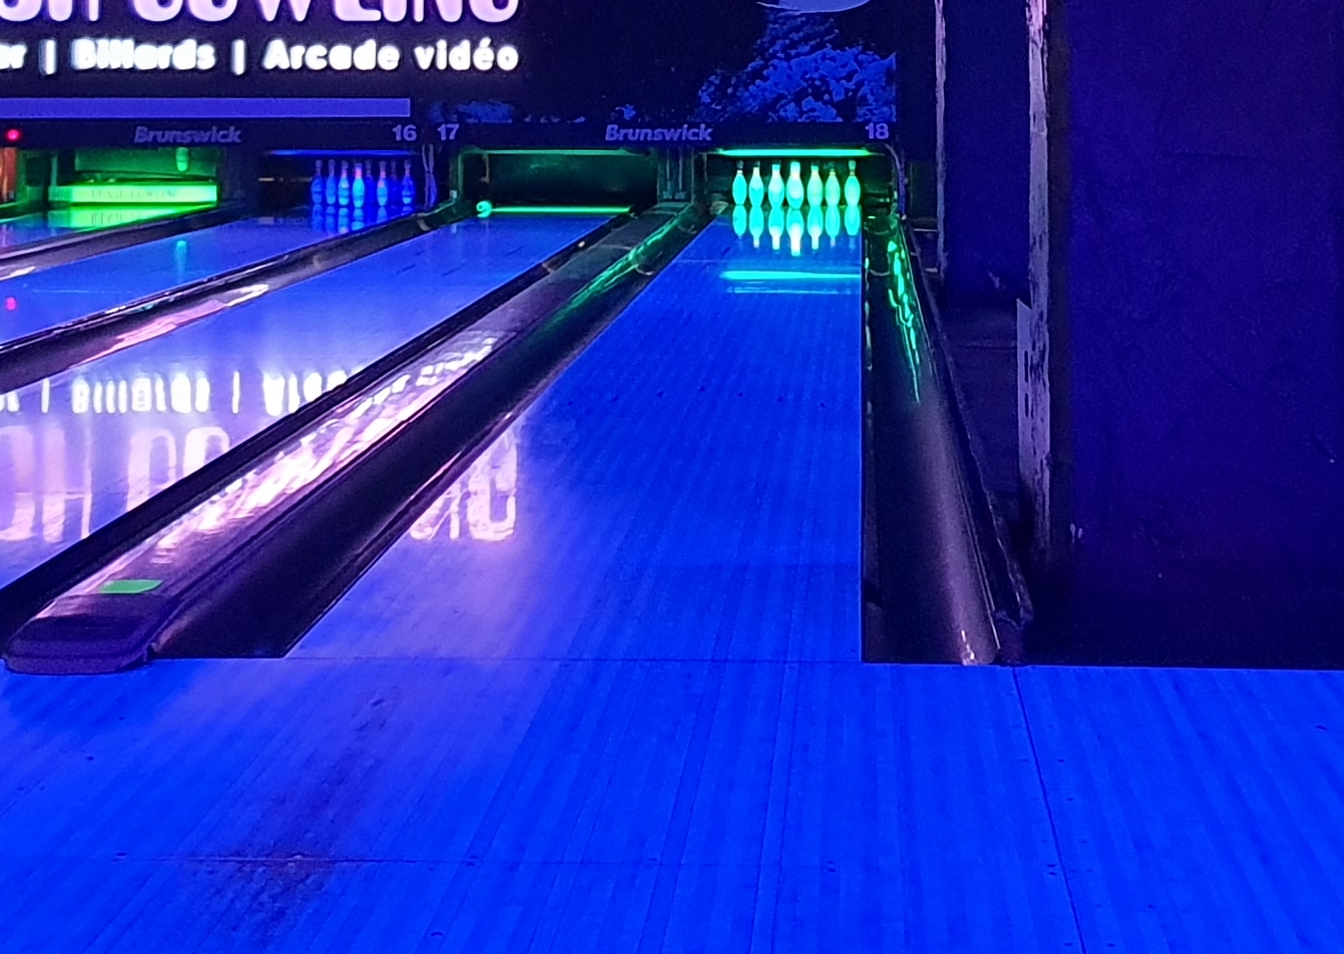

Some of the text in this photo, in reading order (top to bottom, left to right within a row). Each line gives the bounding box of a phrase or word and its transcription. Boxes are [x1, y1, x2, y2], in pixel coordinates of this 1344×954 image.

[72, 37, 216, 72] Billards
[264, 38, 400, 72] Arcade
[415, 38, 519, 72] vidéo
[134, 125, 242, 144] Brunswick
[392, 124, 417, 141] 16
[437, 123, 459, 141] 17
[606, 123, 713, 142] Brunswick
[865, 123, 889, 140] 18
